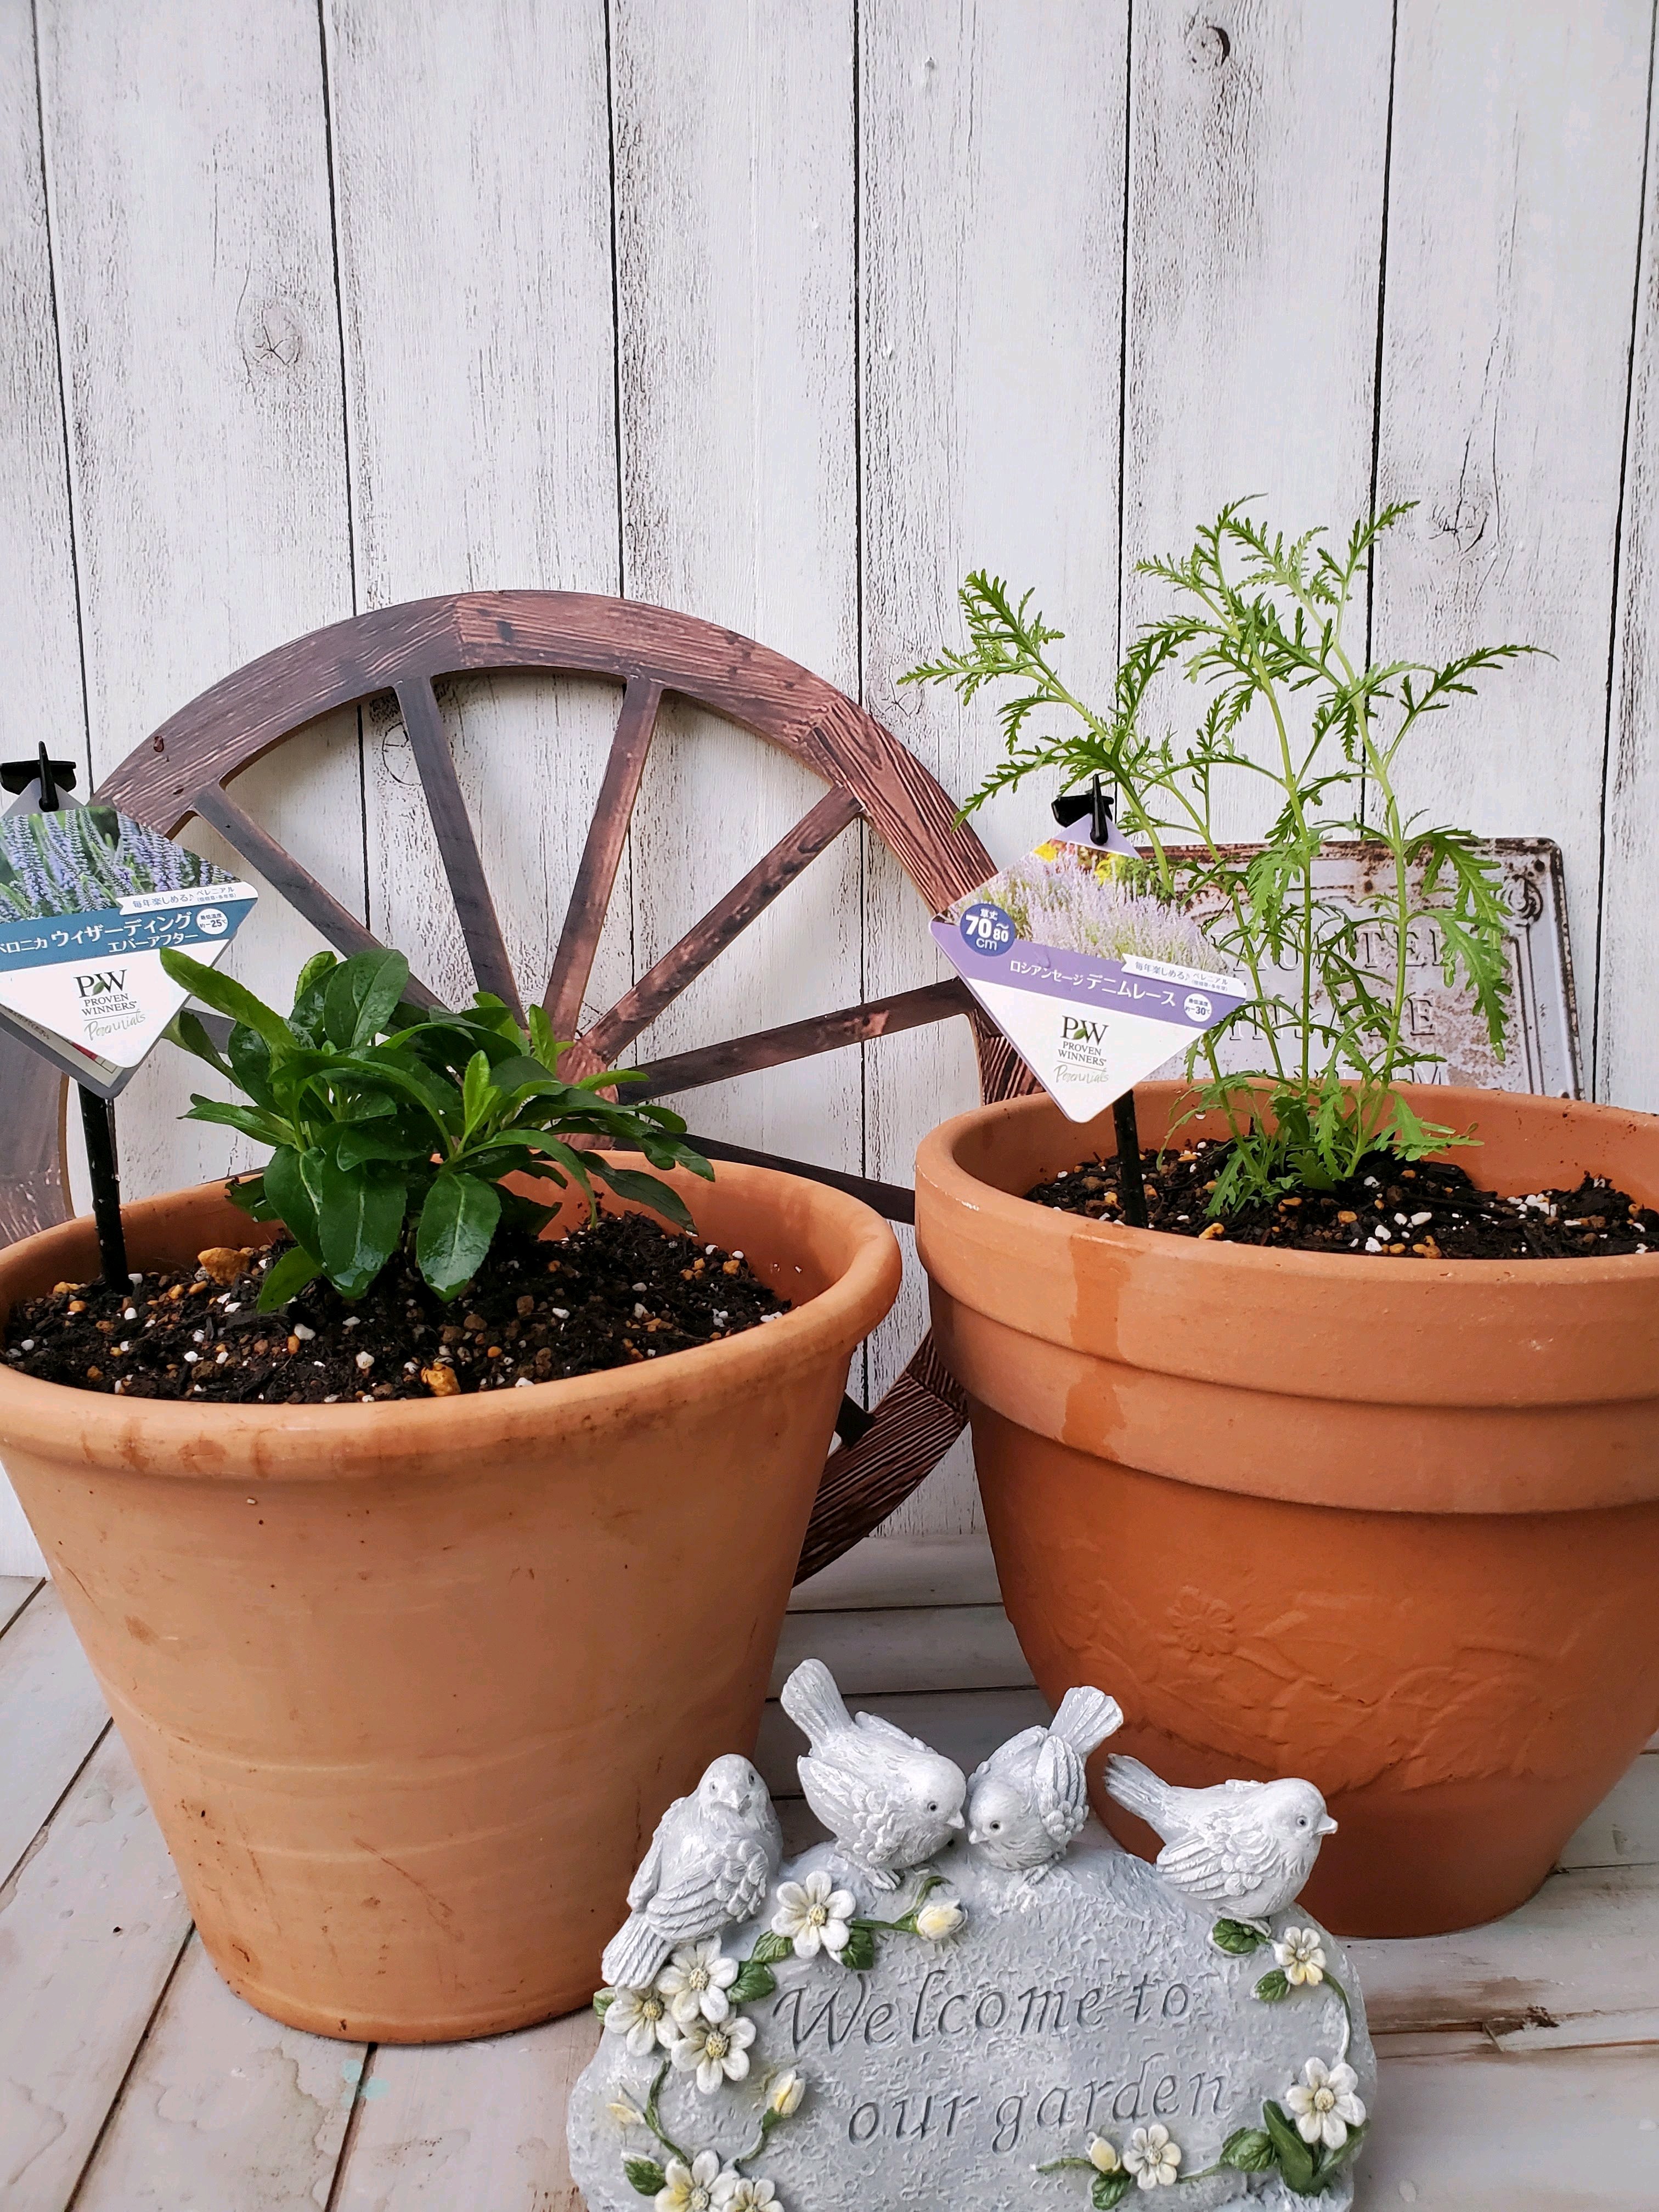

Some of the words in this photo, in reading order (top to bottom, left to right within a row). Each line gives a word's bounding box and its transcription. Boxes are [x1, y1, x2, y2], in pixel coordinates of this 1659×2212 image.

[51, 911, 192, 947] ウィザーディング
[108, 933, 199, 952] エバーアフター
[975, 938, 998, 951] cm
[1010, 960, 1084, 985] ロシアンセージ
[1087, 974, 1176, 1007] デニムレース
[83, 994, 129, 1007] PROVEN
[1063, 1041, 1102, 1056] PROVEN
[773, 1970, 1114, 2054] Welcome
[1131, 1973, 1190, 2023] to
[848, 2091, 979, 2146] our
[991, 2052, 1234, 2155] garden
